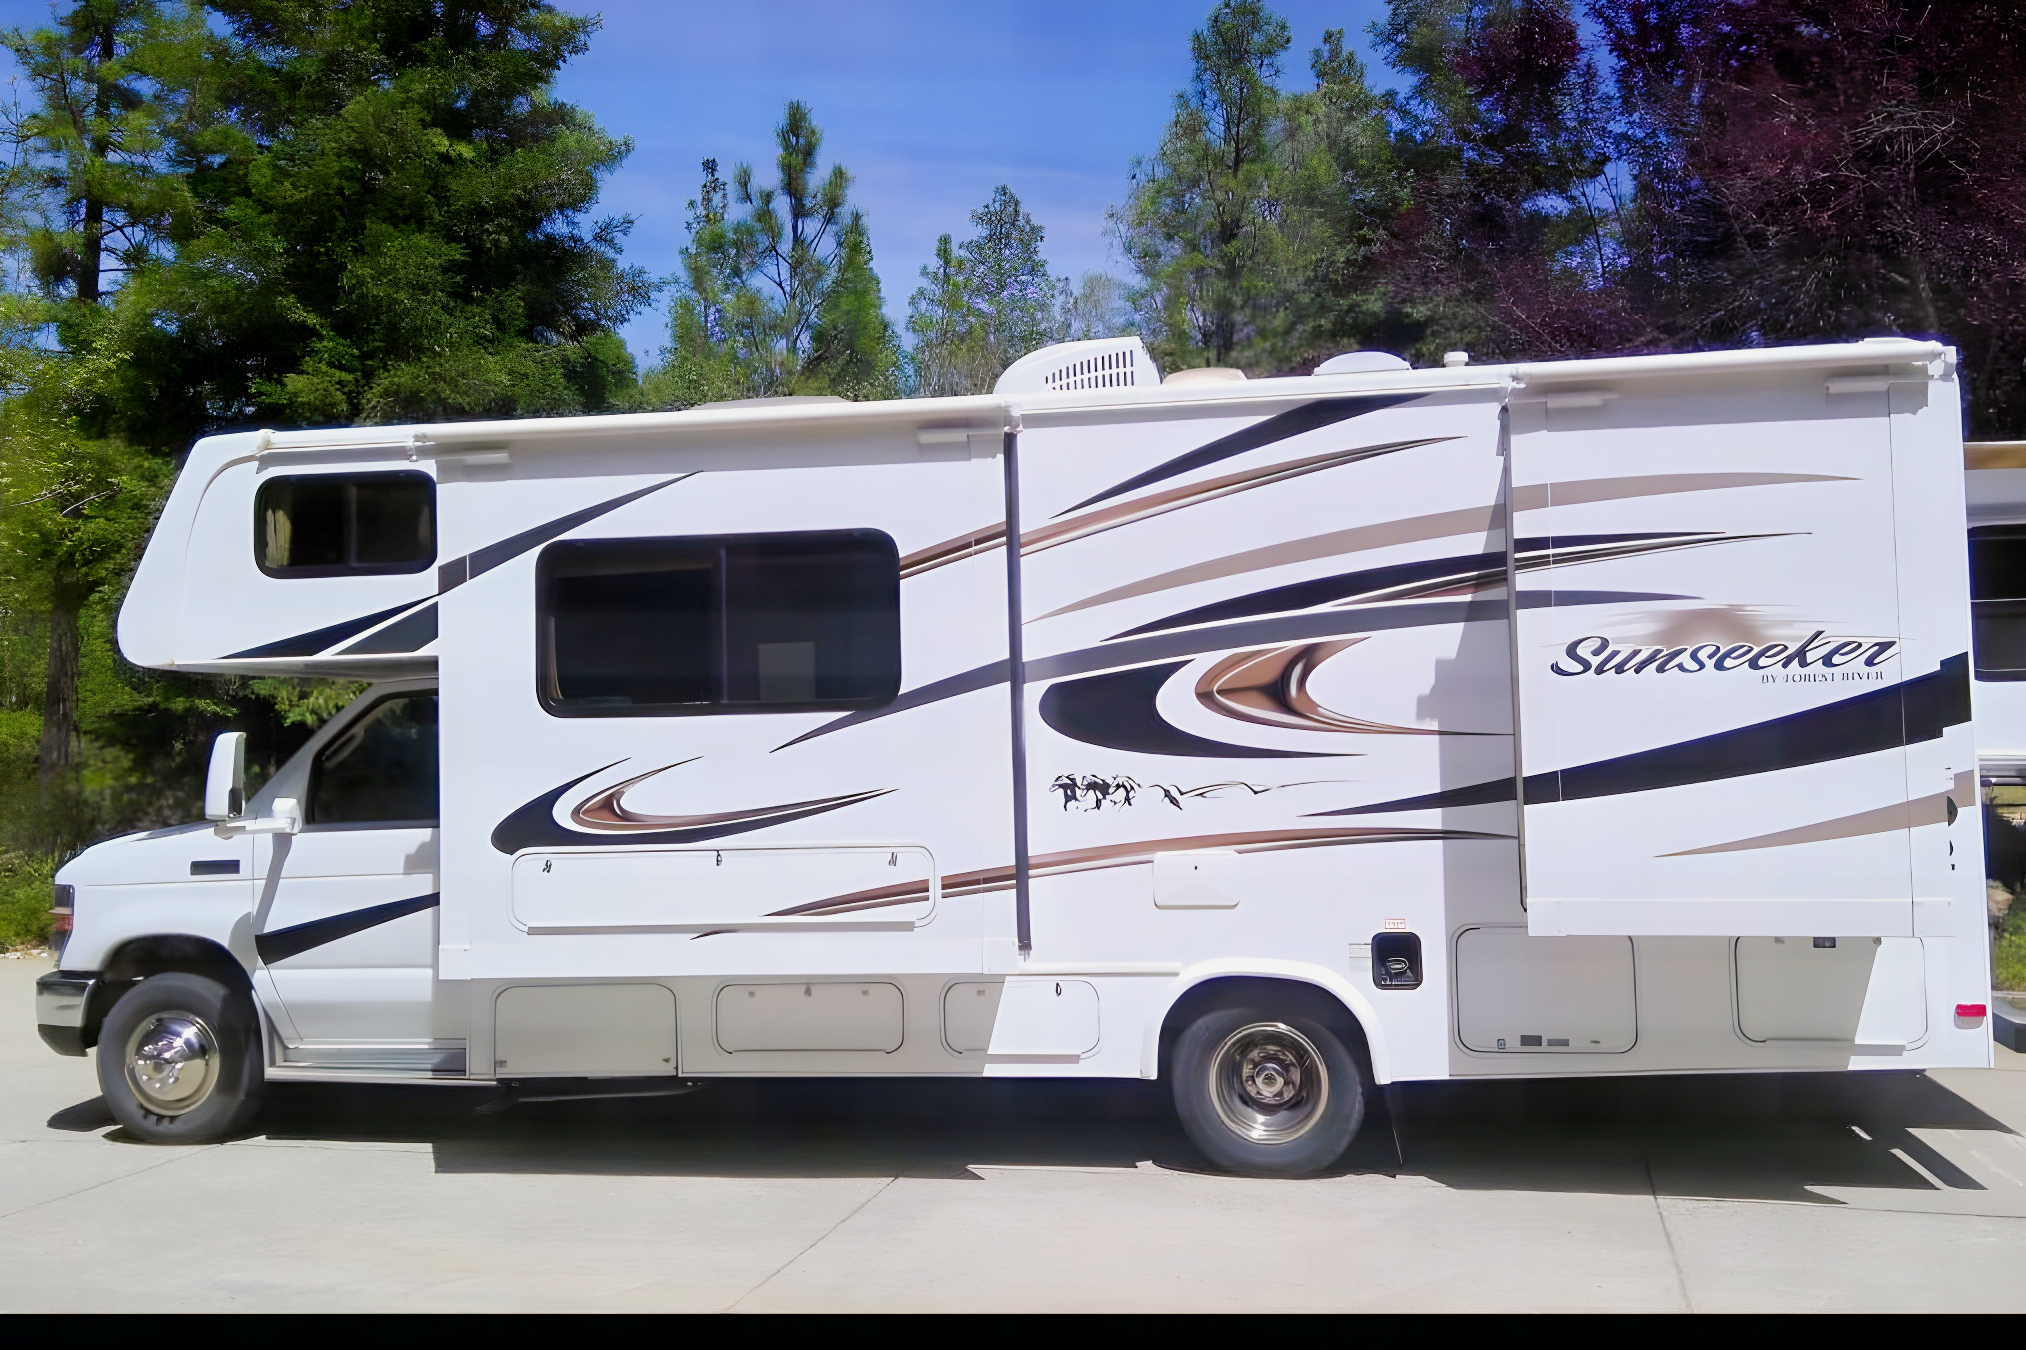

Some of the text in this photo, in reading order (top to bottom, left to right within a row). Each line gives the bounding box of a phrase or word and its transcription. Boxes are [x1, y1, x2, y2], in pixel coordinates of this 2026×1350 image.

[1550, 630, 1900, 676] Sunseeker
[1761, 674, 1778, 684] BY
[1841, 671, 1884, 681] RIVER
